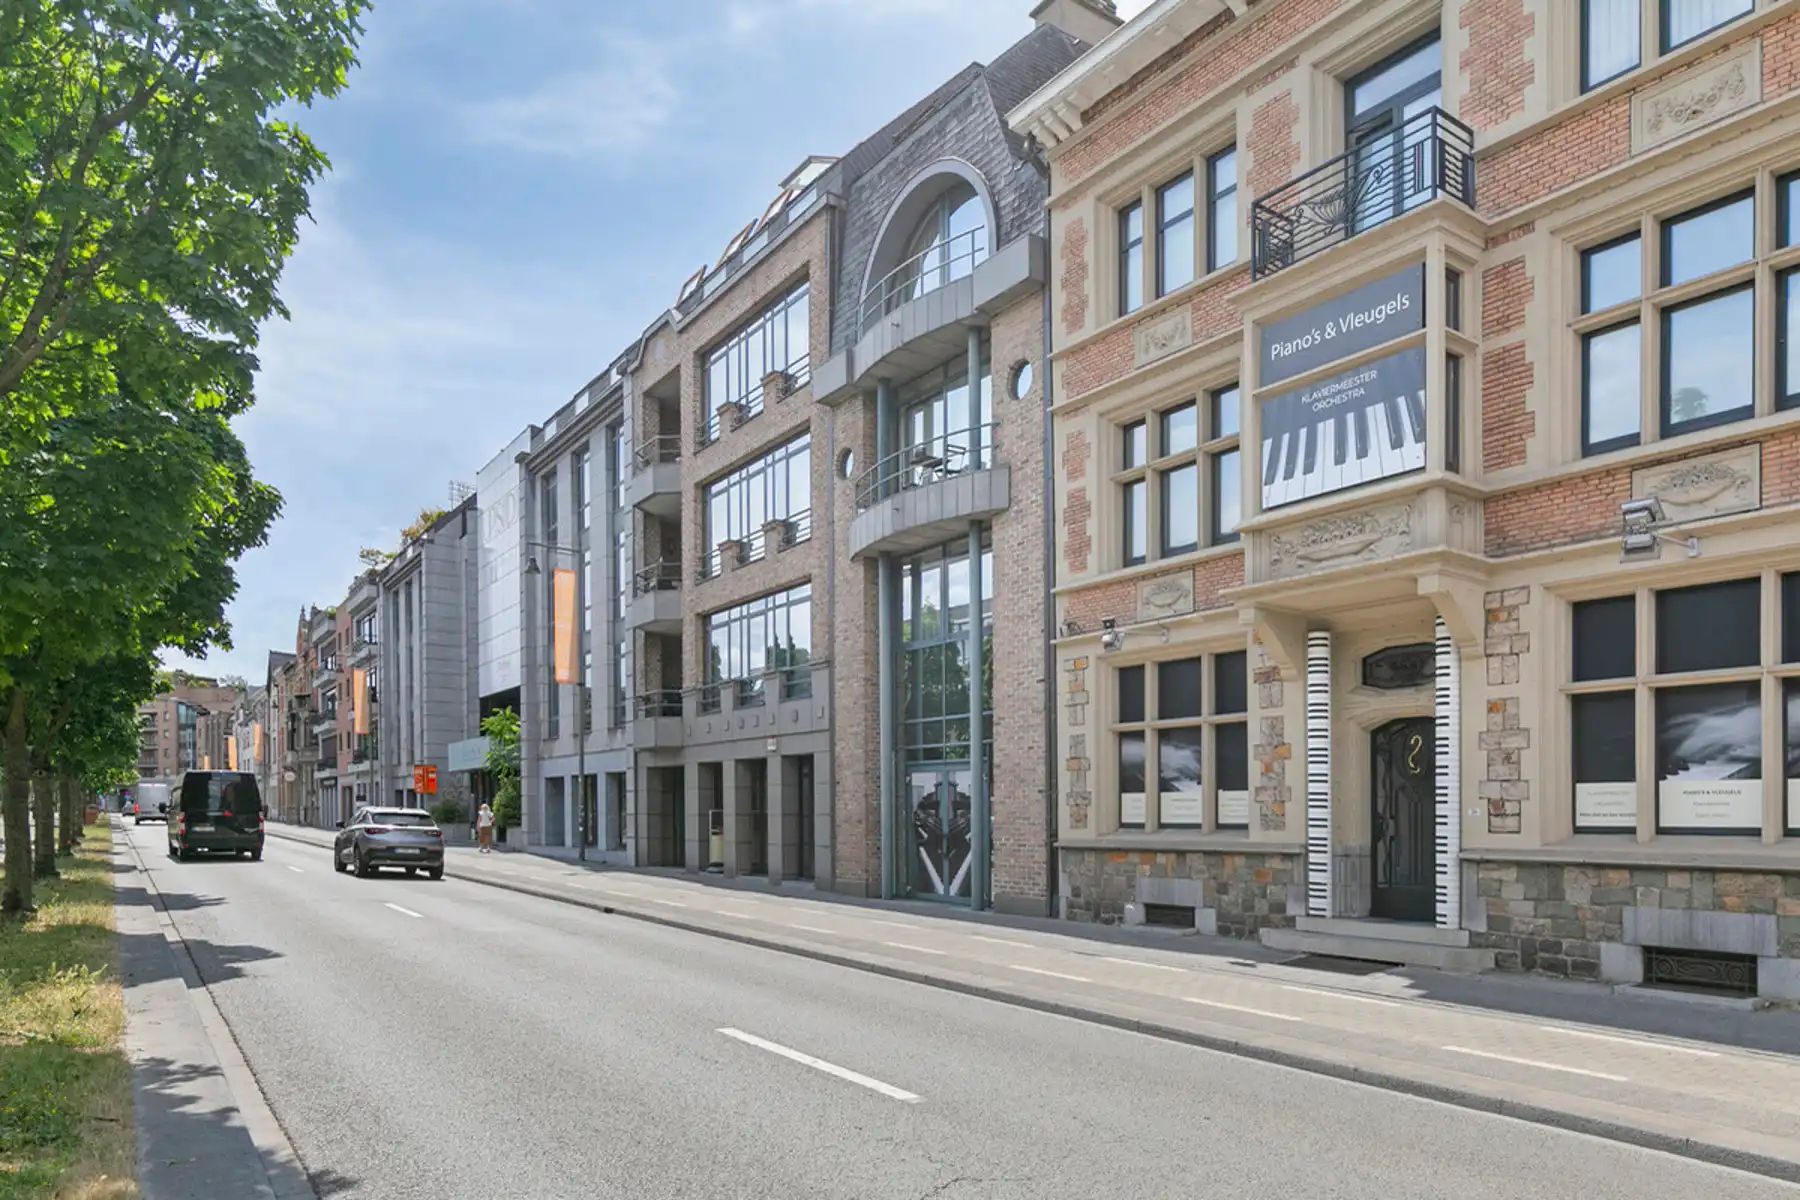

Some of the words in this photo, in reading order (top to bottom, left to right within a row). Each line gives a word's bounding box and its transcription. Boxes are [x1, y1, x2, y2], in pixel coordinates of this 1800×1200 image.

[1271, 328, 1321, 361] Piano's
[1324, 321, 1337, 340] &
[1339, 292, 1410, 334] Vleugels
[1301, 370, 1378, 405] KLAVIERMEESTER
[1312, 387, 1366, 412] ORCHESTRA
